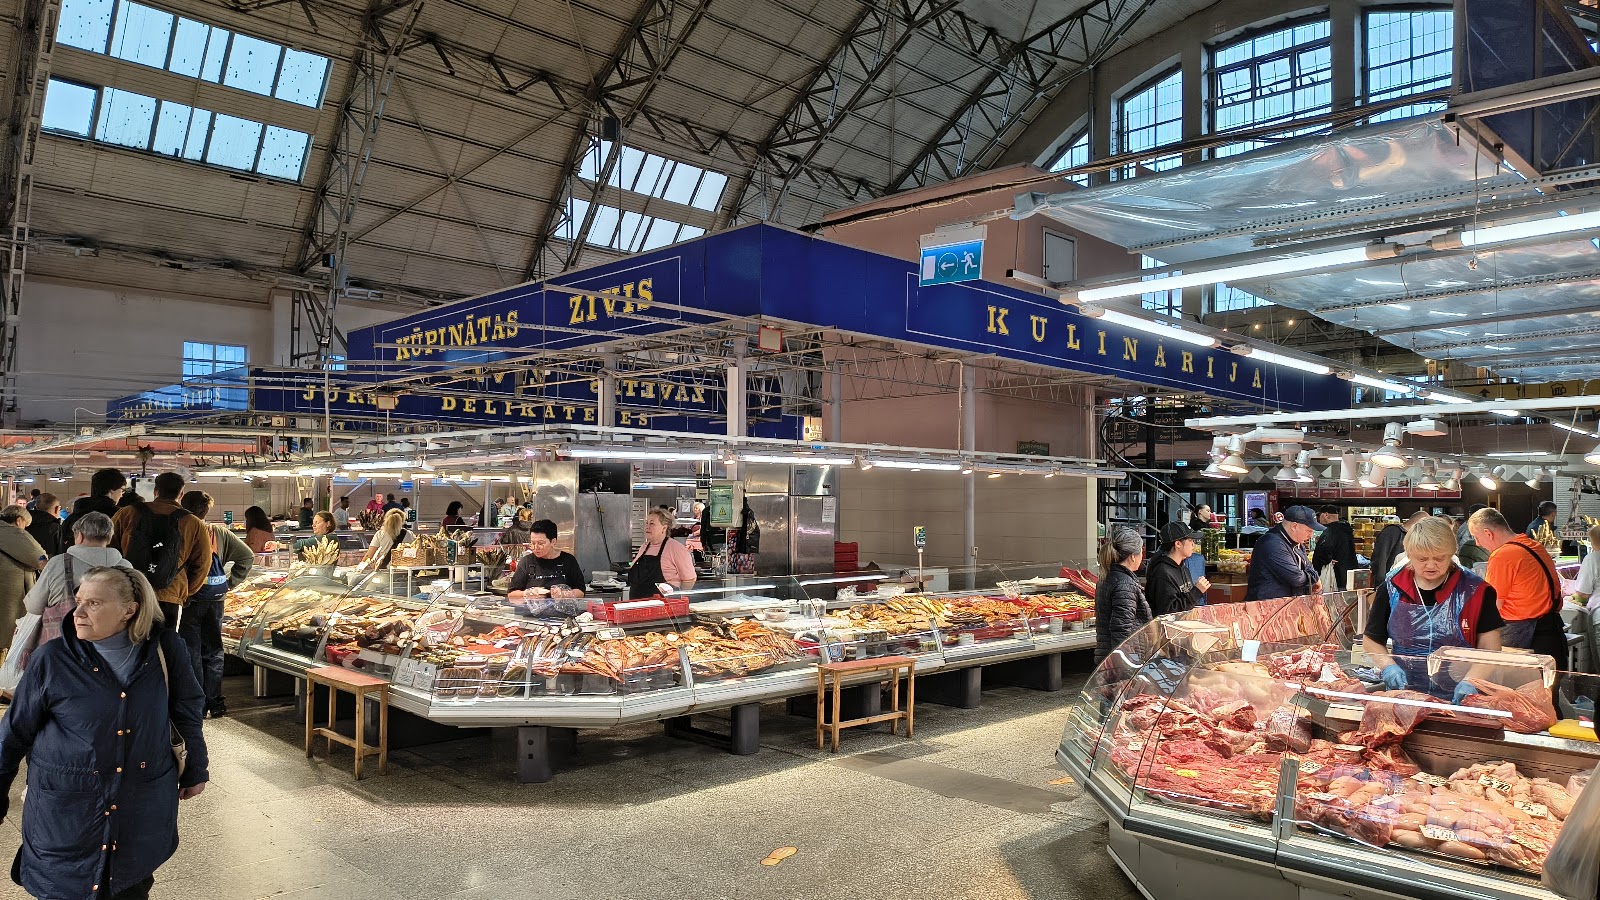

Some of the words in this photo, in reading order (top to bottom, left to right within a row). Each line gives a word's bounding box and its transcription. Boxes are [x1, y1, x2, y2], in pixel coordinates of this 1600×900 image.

[395, 309, 519, 361] KŪPINĀTAS
[569, 277, 653, 325] ZIVIS
[441, 396, 648, 426] DELIKATEES
